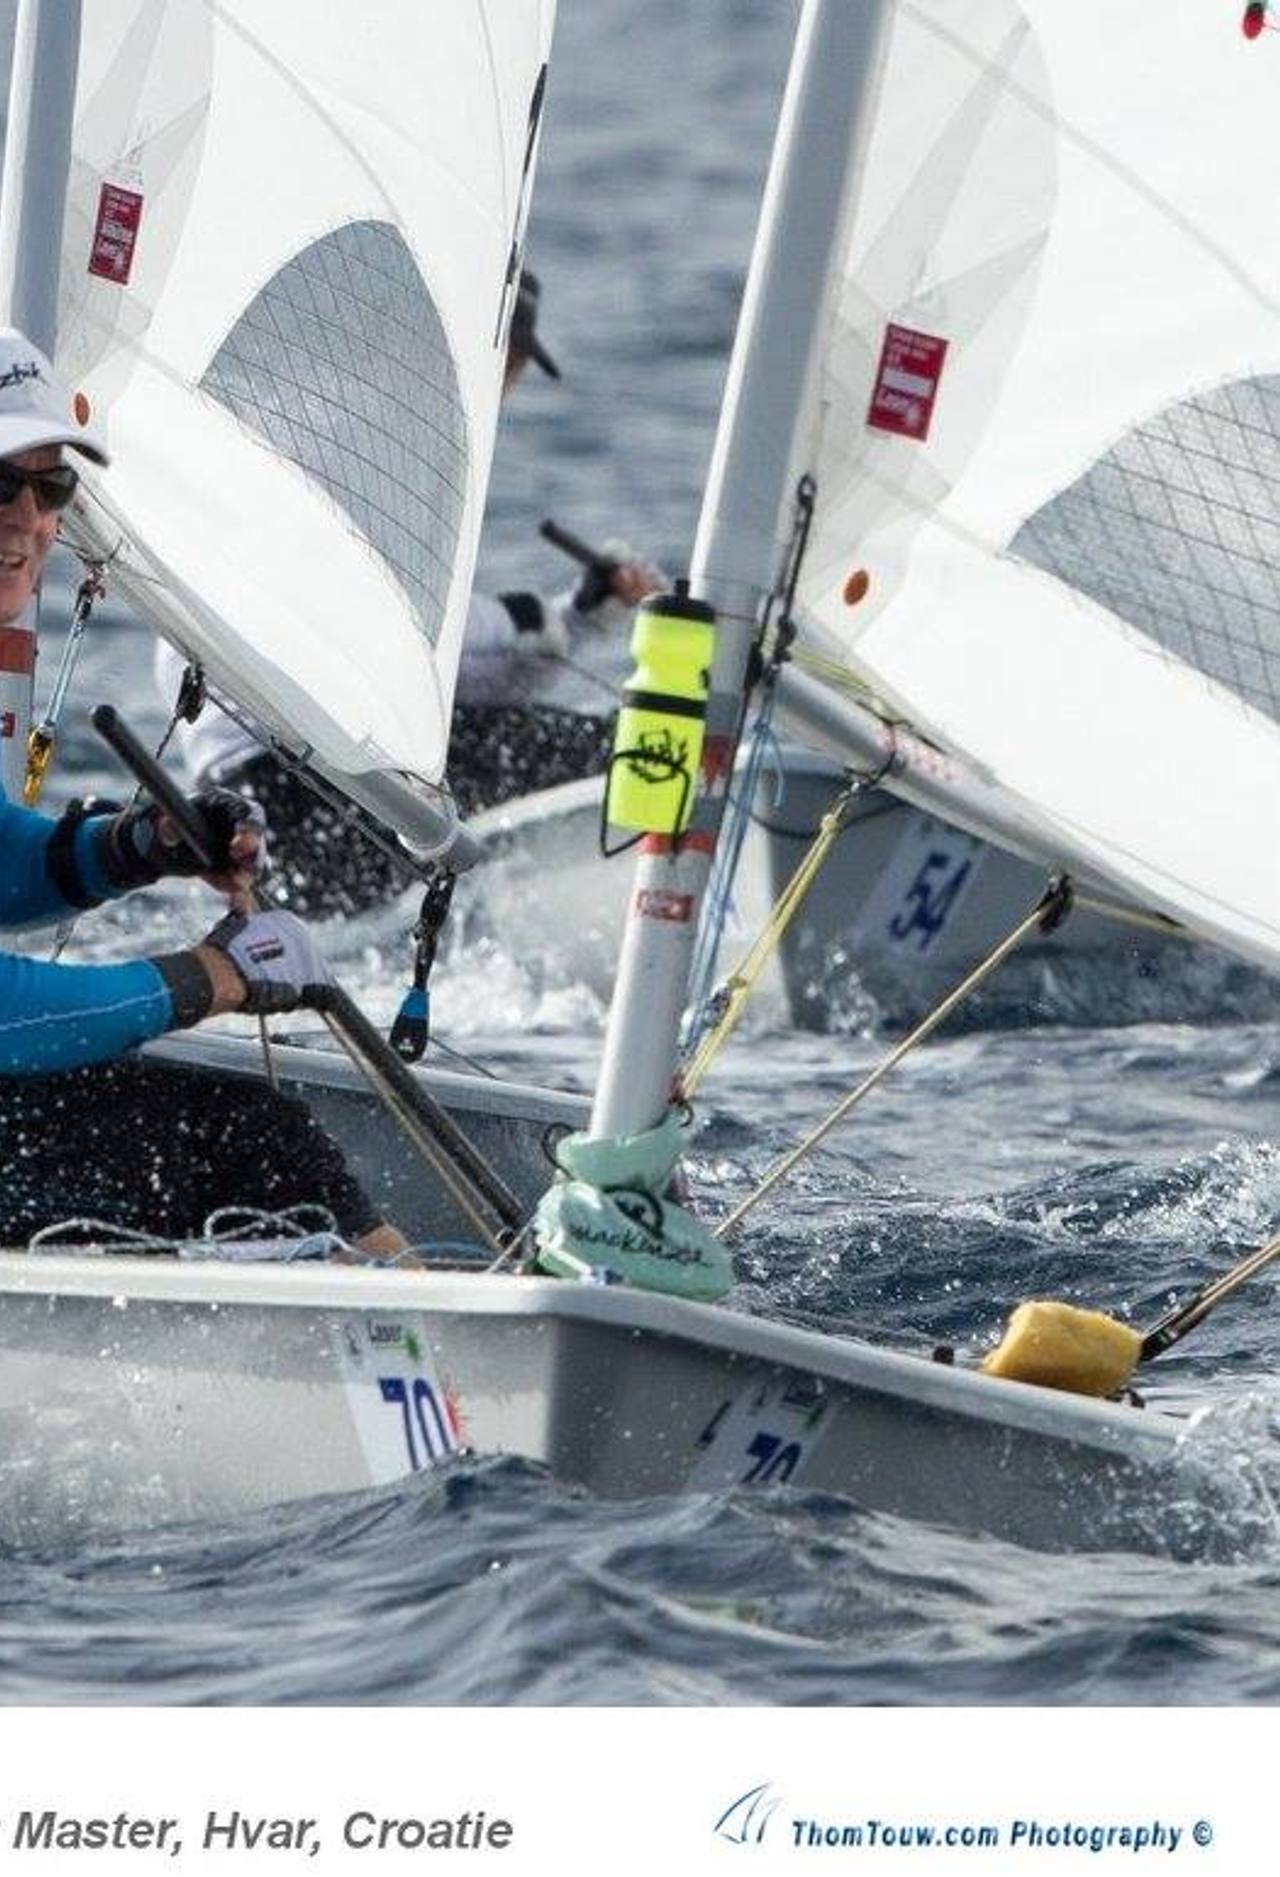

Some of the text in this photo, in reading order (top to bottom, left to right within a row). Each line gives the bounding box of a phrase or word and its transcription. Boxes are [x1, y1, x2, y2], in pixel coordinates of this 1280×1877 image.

[888, 852, 972, 952] 54
[377, 1376, 454, 1471] 70
[740, 1431, 802, 1484] 70
